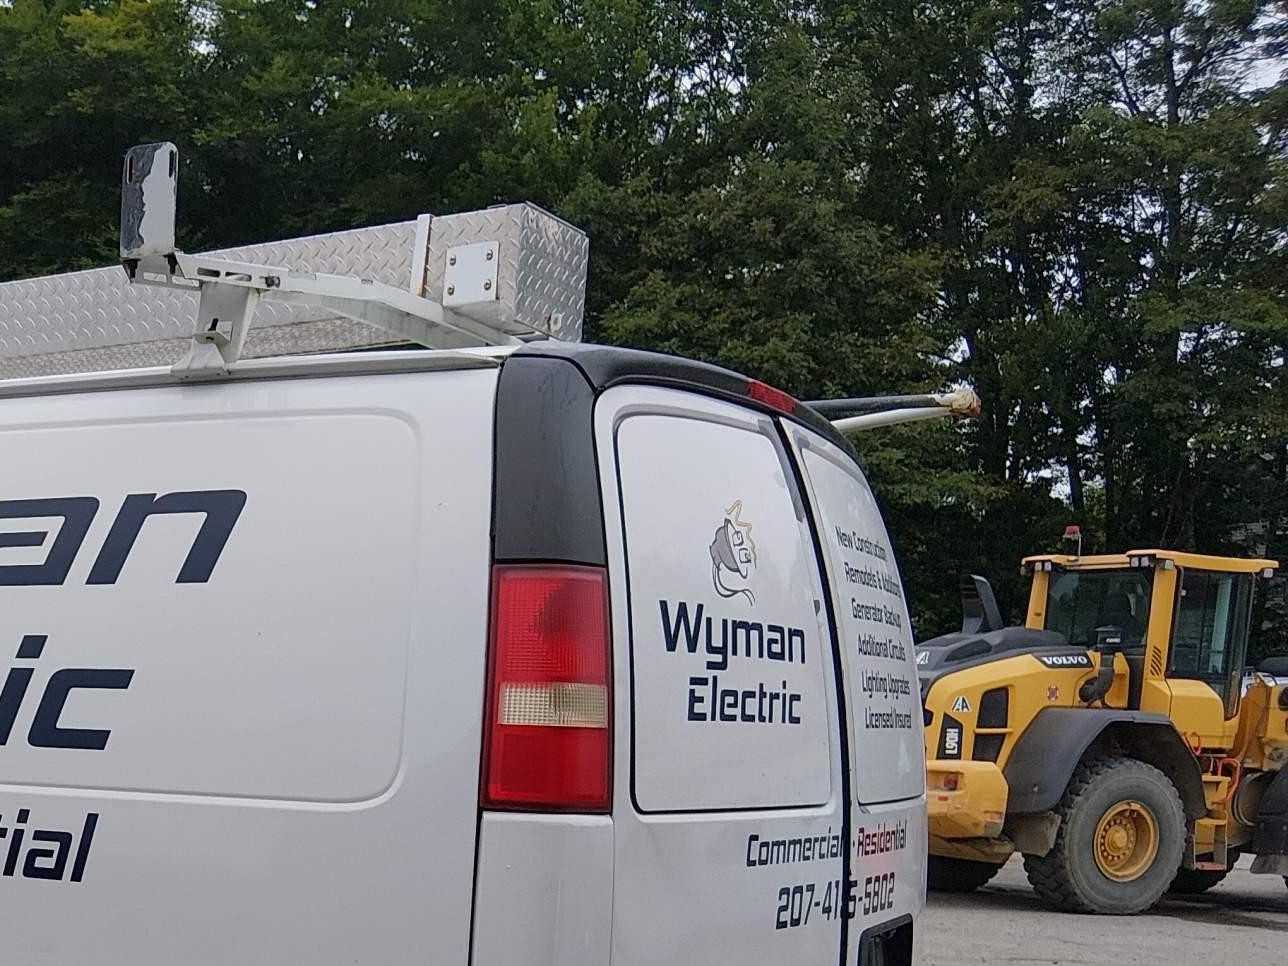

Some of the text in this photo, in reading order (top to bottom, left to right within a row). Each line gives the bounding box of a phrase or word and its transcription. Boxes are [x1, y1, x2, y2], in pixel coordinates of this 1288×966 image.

[835, 526, 853, 549] New
[851, 598, 883, 622] Generator
[659, 600, 805, 671] Wyman
[858, 634, 888, 658] Additional
[1043, 656, 1088, 665] VOLVO
[862, 670, 910, 700] Lighting Upgrades
[687, 675, 801, 725] Electric
[945, 728, 959, 755] L90H
[857, 819, 908, 857] Residential
